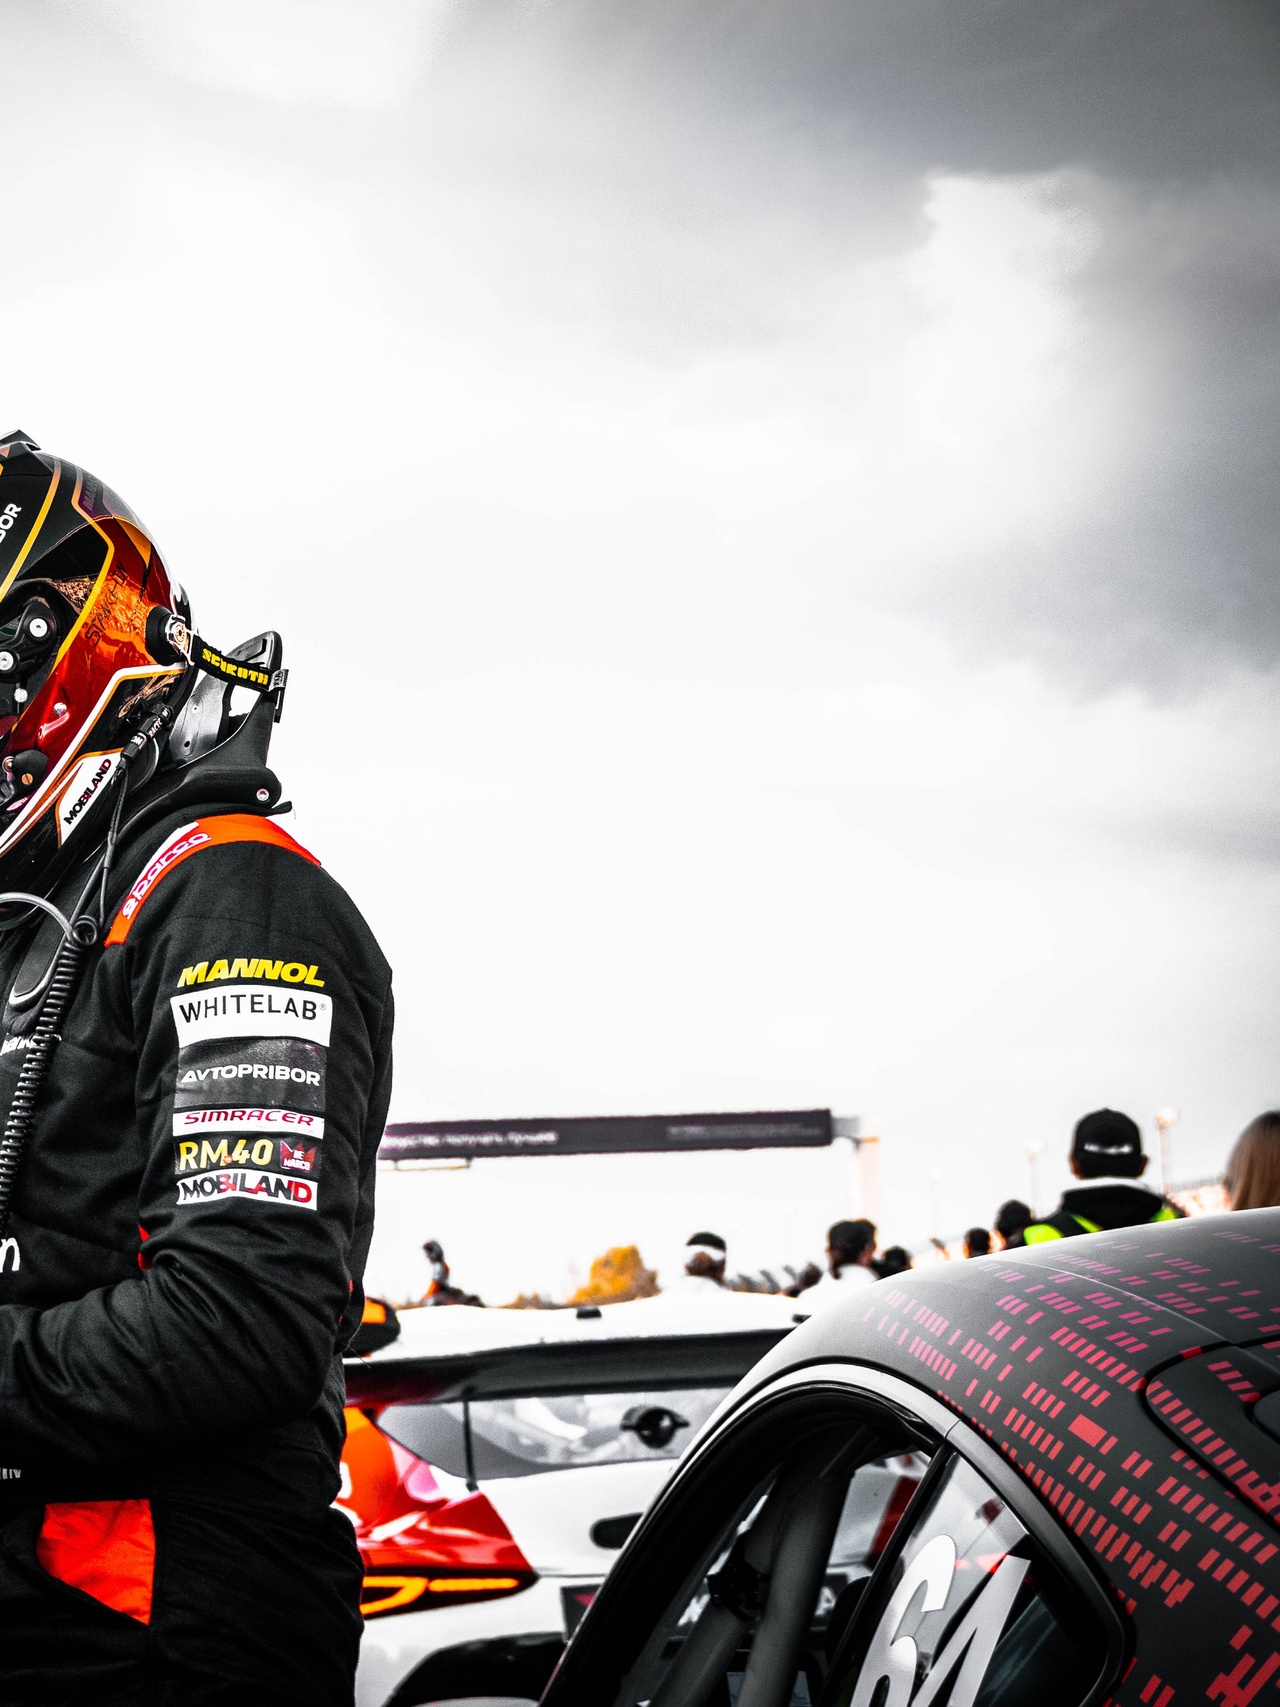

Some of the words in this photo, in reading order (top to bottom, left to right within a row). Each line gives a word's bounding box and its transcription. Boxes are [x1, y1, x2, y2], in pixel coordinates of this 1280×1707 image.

[63, 758, 112, 825] MOBILAND
[122, 833, 212, 920] sparco
[177, 958, 325, 988] MANNOL
[179, 994, 317, 1023] WHITELAB
[181, 1064, 321, 1086] AVTOPRIBOR
[184, 1110, 314, 1126] SIMRACER
[181, 1173, 312, 1203] MOBILAND
